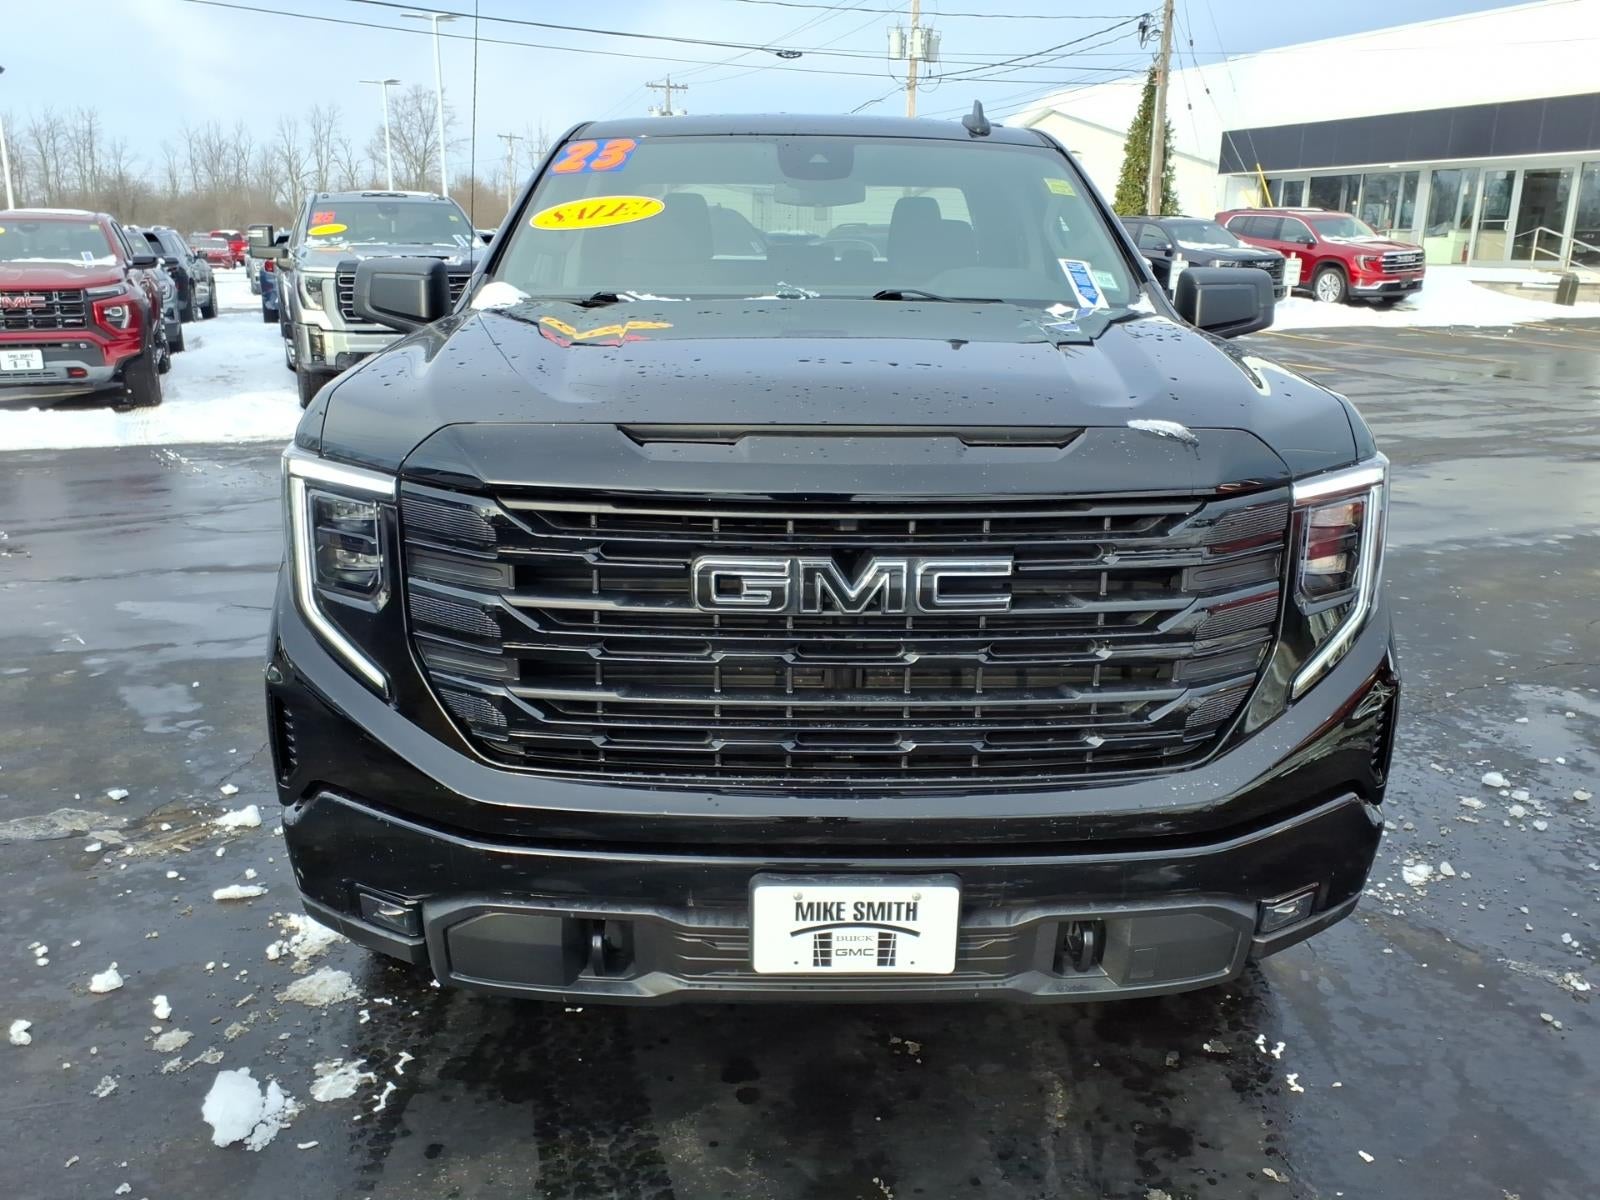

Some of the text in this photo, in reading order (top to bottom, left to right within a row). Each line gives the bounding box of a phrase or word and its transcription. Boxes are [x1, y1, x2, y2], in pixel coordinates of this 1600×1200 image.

[553, 138, 636, 174] 23
[0, 296, 46, 308] MC
[691, 556, 1013, 615] GMC
[795, 901, 918, 921] MIKE SMITH
[835, 948, 874, 957] GMC
